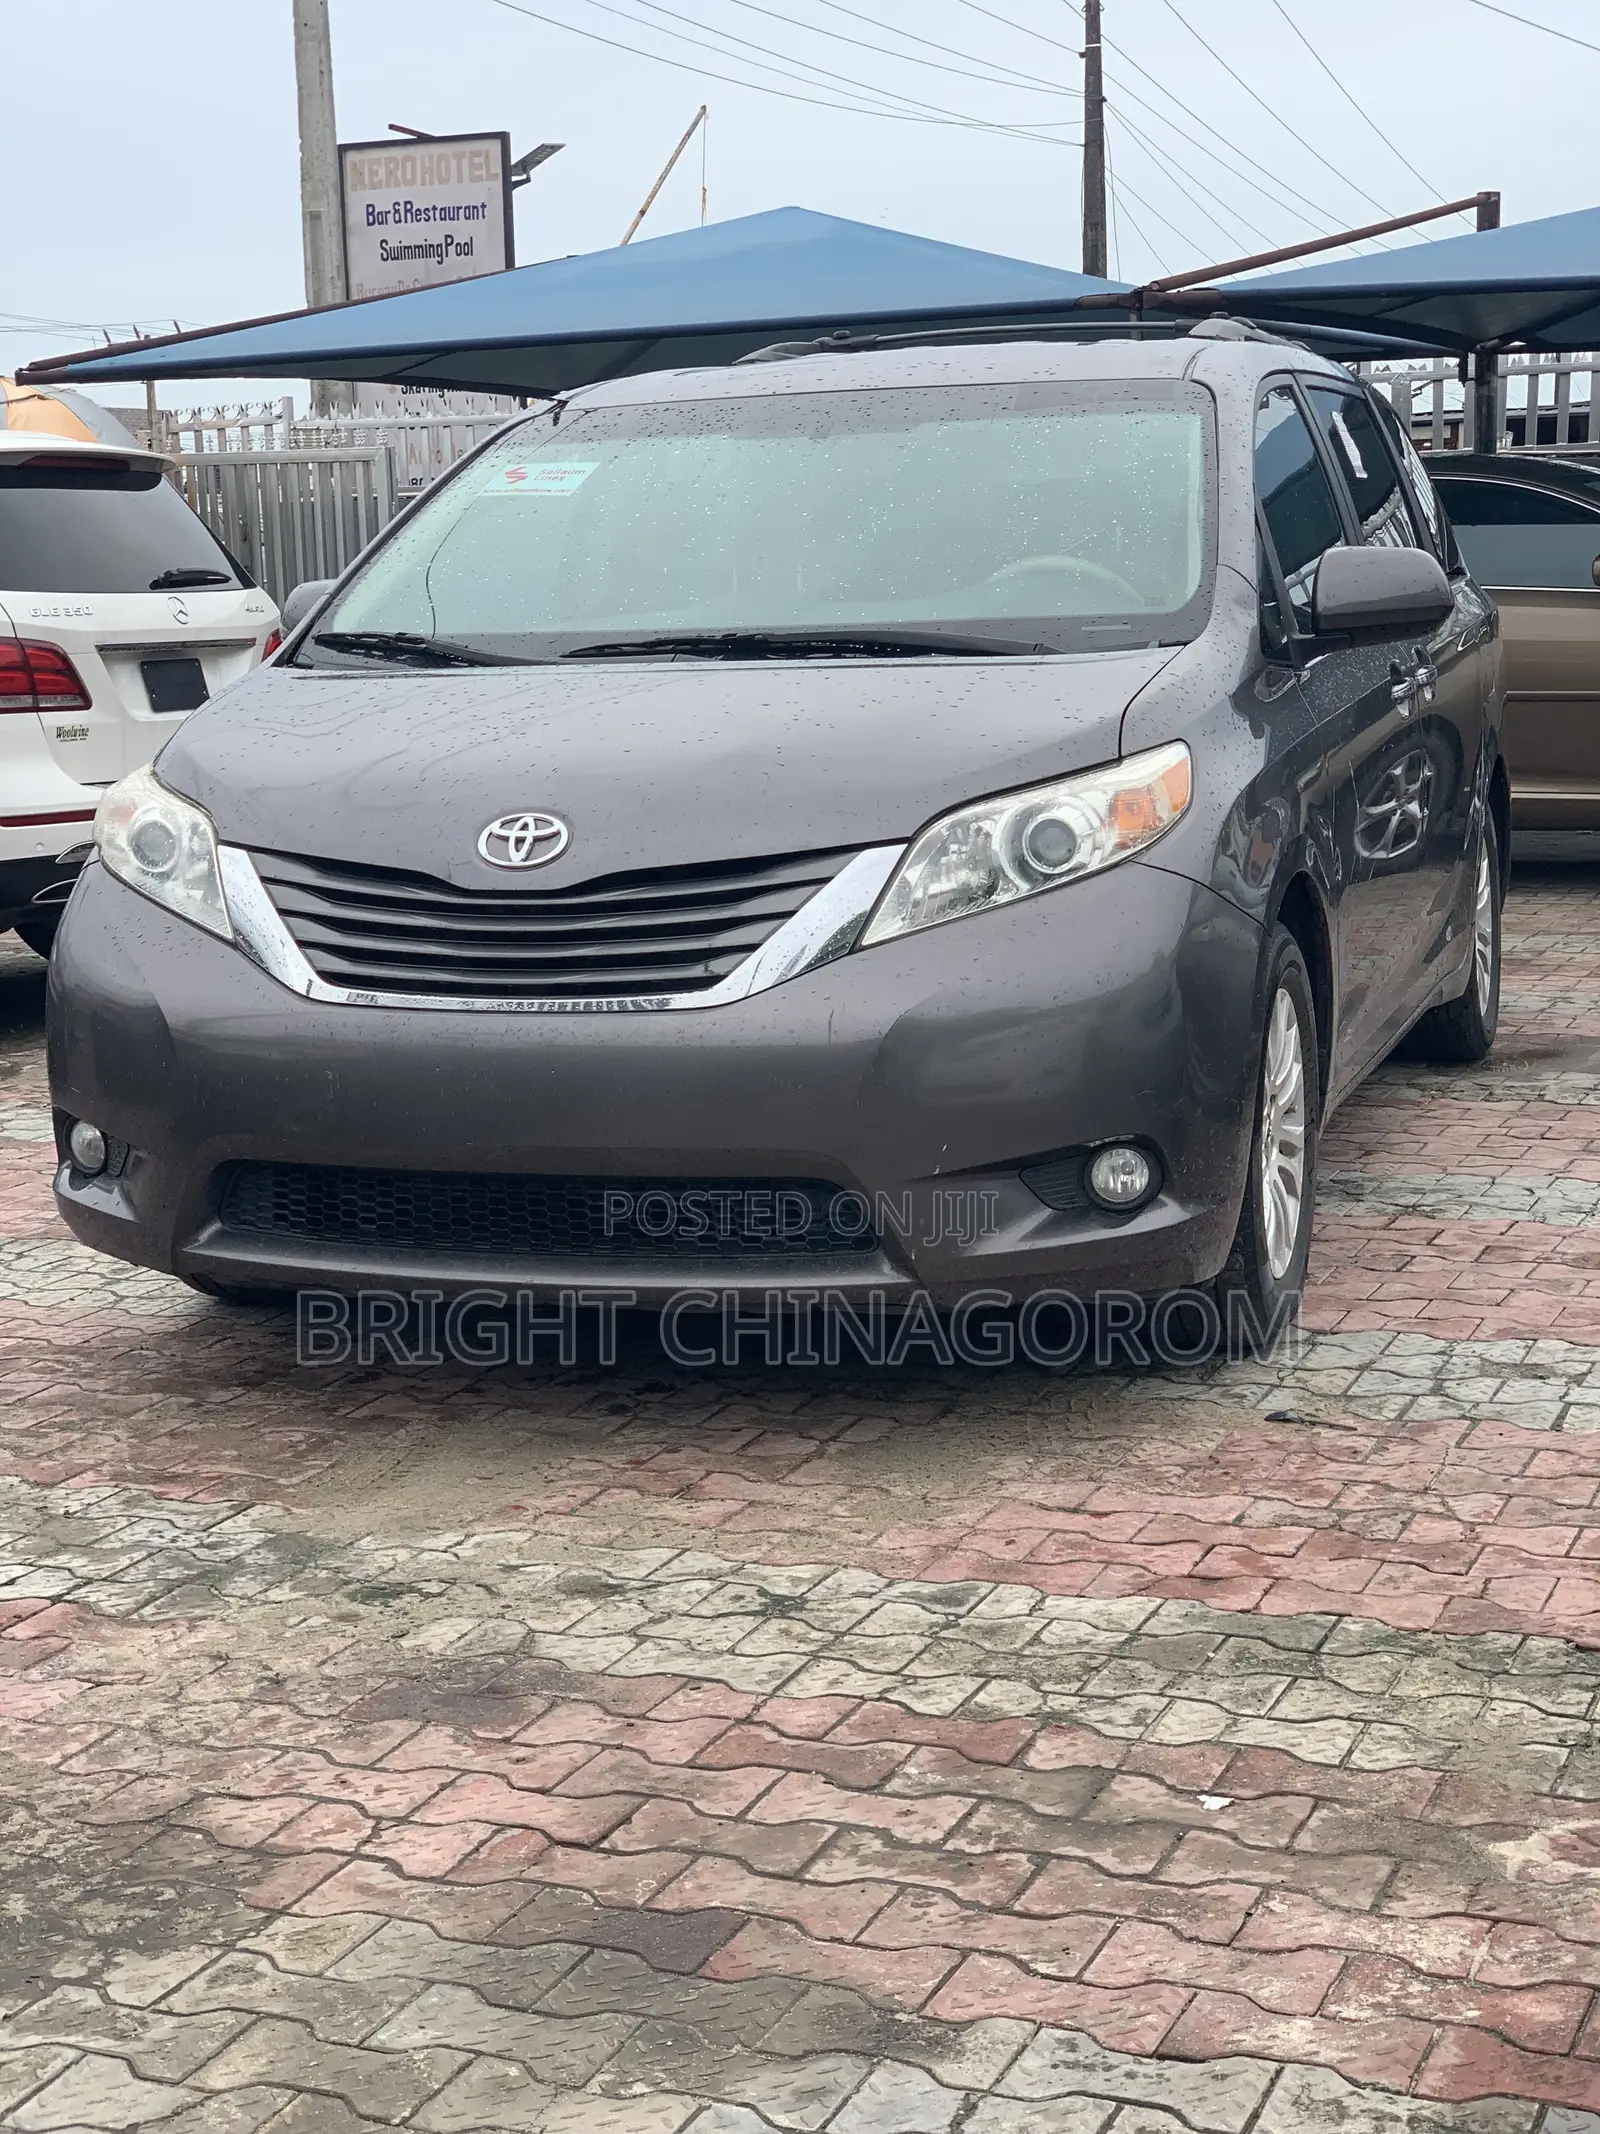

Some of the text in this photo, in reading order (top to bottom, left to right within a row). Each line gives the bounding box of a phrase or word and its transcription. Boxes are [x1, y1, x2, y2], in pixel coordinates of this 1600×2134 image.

[365, 200, 487, 226] Bar&Restaurant
[30, 605, 93, 617] GLE 350
